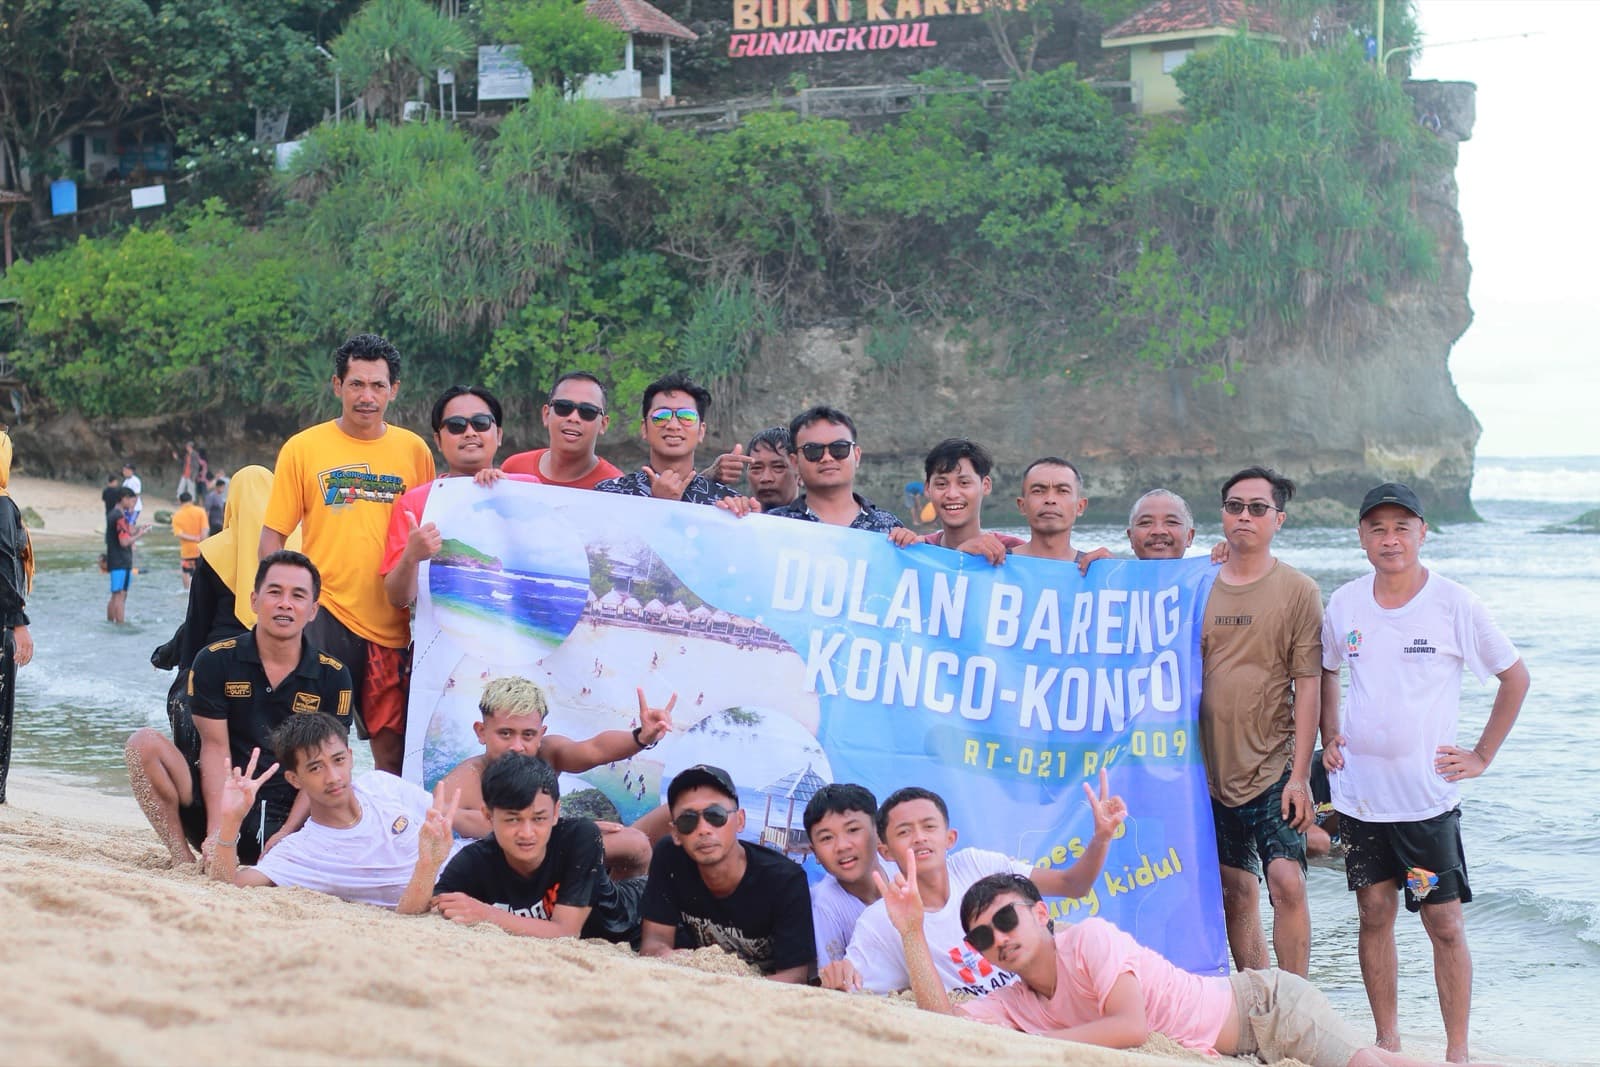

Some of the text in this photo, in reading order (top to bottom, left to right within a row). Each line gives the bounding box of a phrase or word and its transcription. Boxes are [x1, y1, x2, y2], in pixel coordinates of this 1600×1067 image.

[728, 23, 937, 58] GUNUNGKIDUL
[772, 550, 1180, 656] DOLAN BARENG
[804, 628, 1182, 733] KONCO-KONCO
[963, 739, 1067, 778] RT-021
[1104, 847, 1183, 897] kidul
